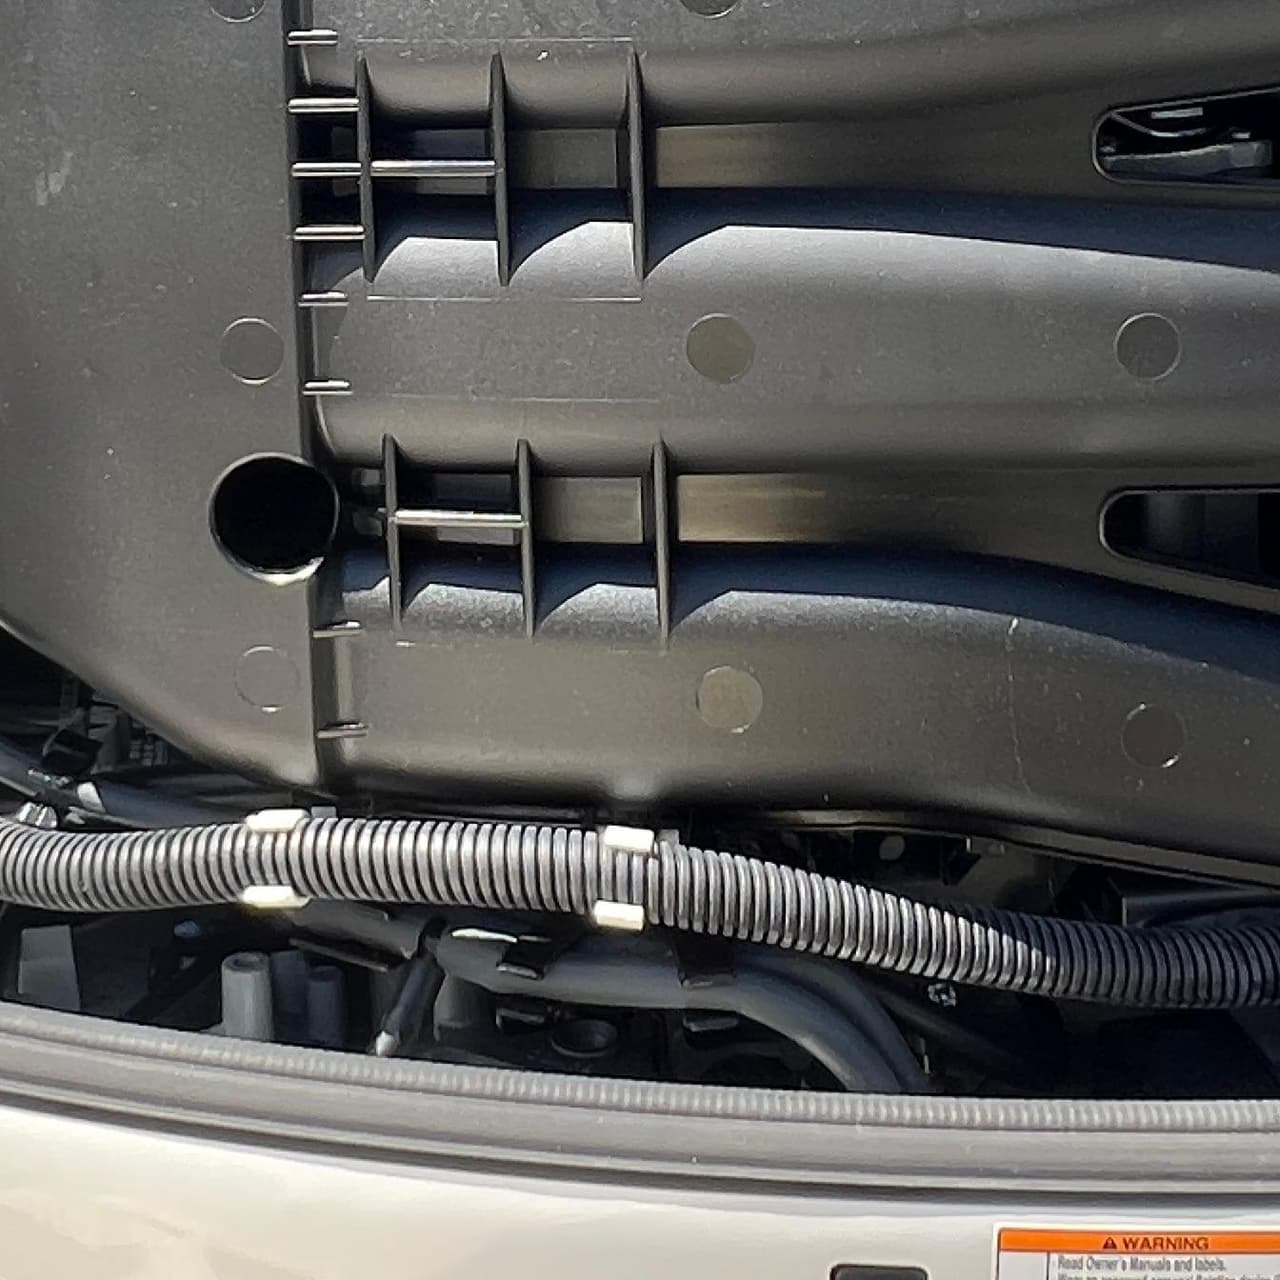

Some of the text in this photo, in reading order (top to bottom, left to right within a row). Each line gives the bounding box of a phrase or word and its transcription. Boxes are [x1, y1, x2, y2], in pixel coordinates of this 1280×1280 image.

[1122, 1236, 1209, 1251] WARNING
[1057, 1255, 1083, 1271] Read
[1130, 1255, 1171, 1272] Manuals
[1173, 1256, 1192, 1272] and
